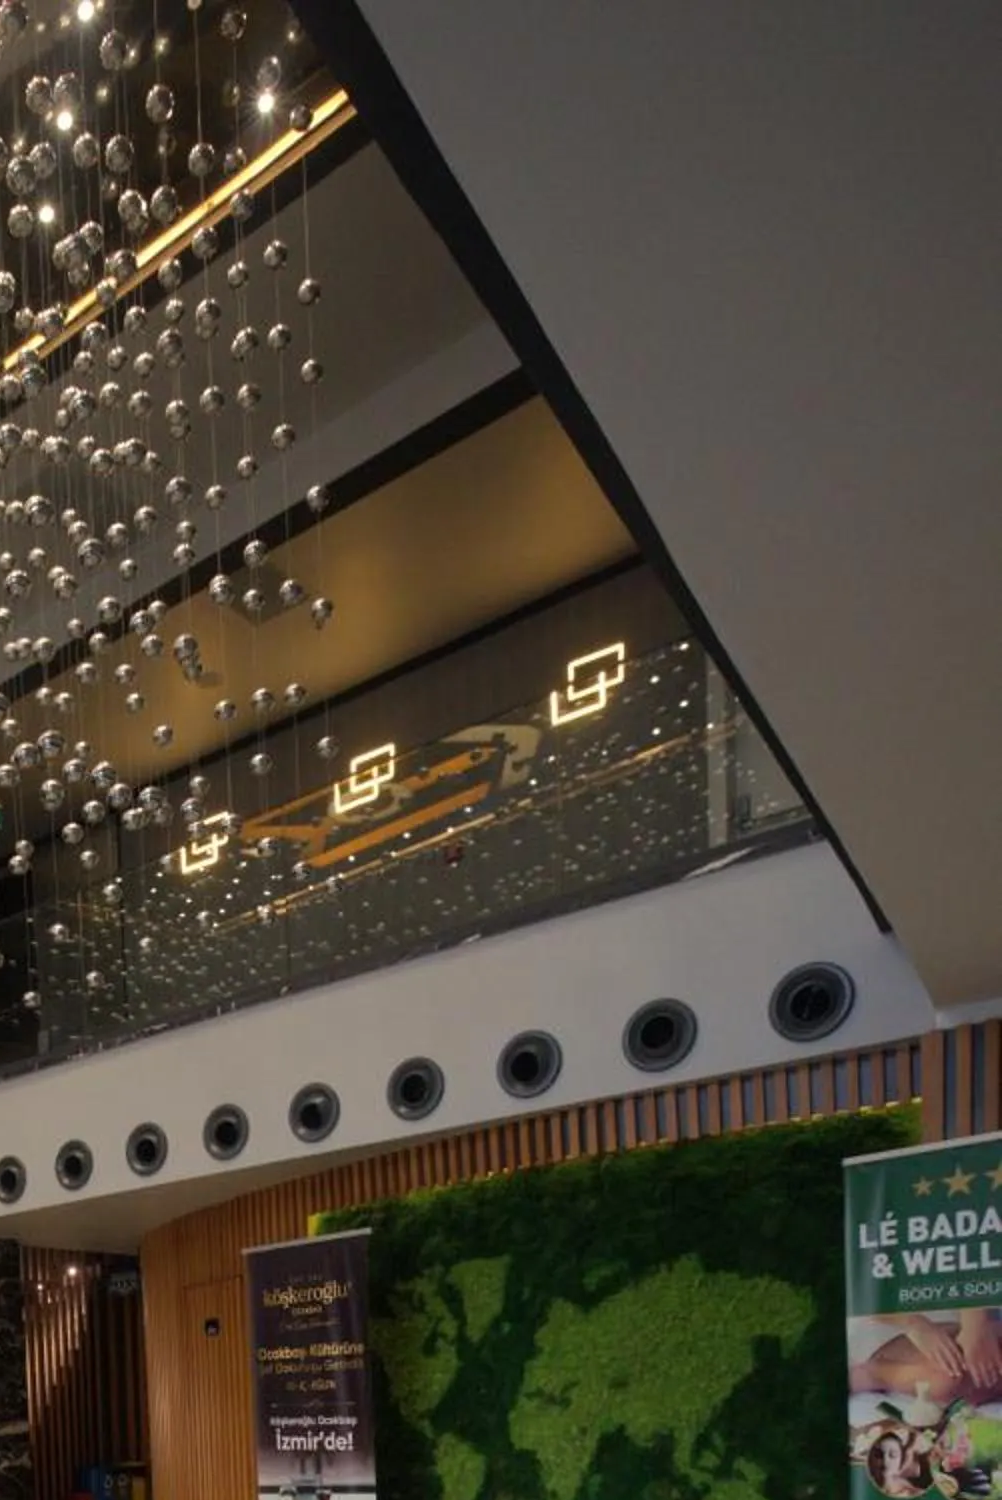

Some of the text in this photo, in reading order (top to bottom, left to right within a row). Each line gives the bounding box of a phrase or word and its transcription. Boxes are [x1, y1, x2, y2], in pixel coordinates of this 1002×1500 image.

[858, 1205, 1002, 1249] LÉ BADA
[871, 1240, 1001, 1279] & WELL
[899, 1280, 1002, 1302] BODY & SOU
[276, 1427, 354, 1451] İzmir'de!
